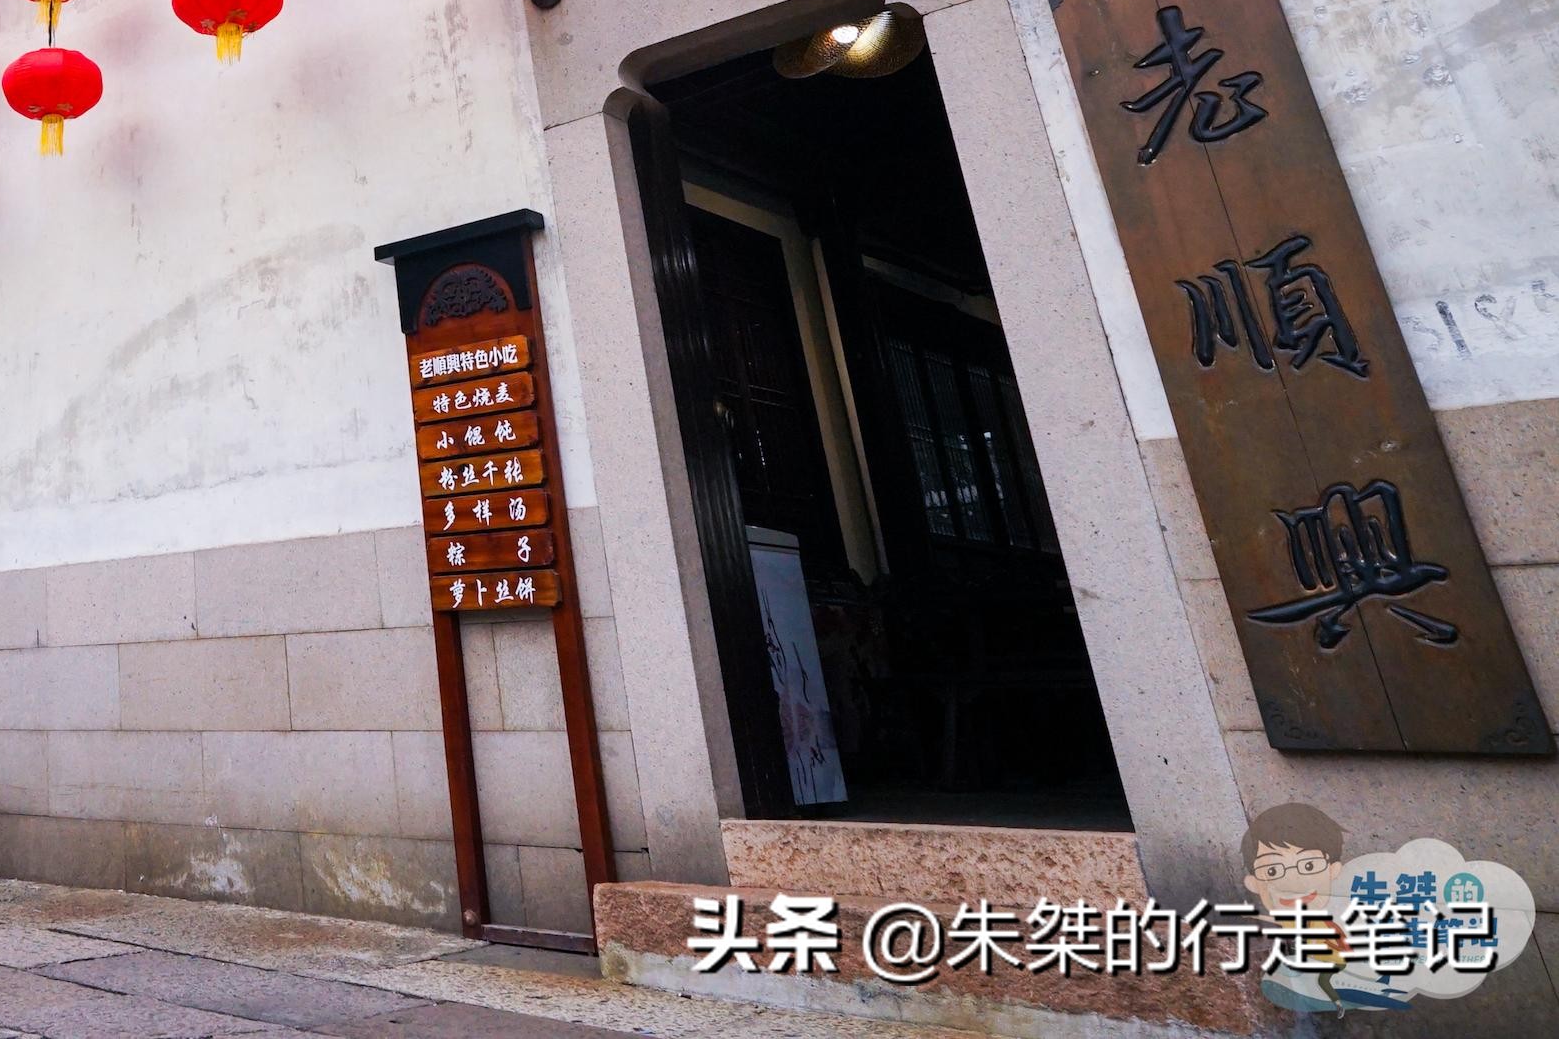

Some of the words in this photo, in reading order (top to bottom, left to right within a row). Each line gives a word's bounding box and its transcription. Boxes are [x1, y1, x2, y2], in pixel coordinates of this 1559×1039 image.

[1120, 6, 1459, 649] 老順興
[419, 343, 519, 379] 老順興特色小吃
[432, 382, 515, 414] 特色烧麦
[436, 419, 517, 450] 小馄饨
[438, 456, 524, 491] 粉丝千张
[449, 576, 537, 609] 萝卜丝饼
